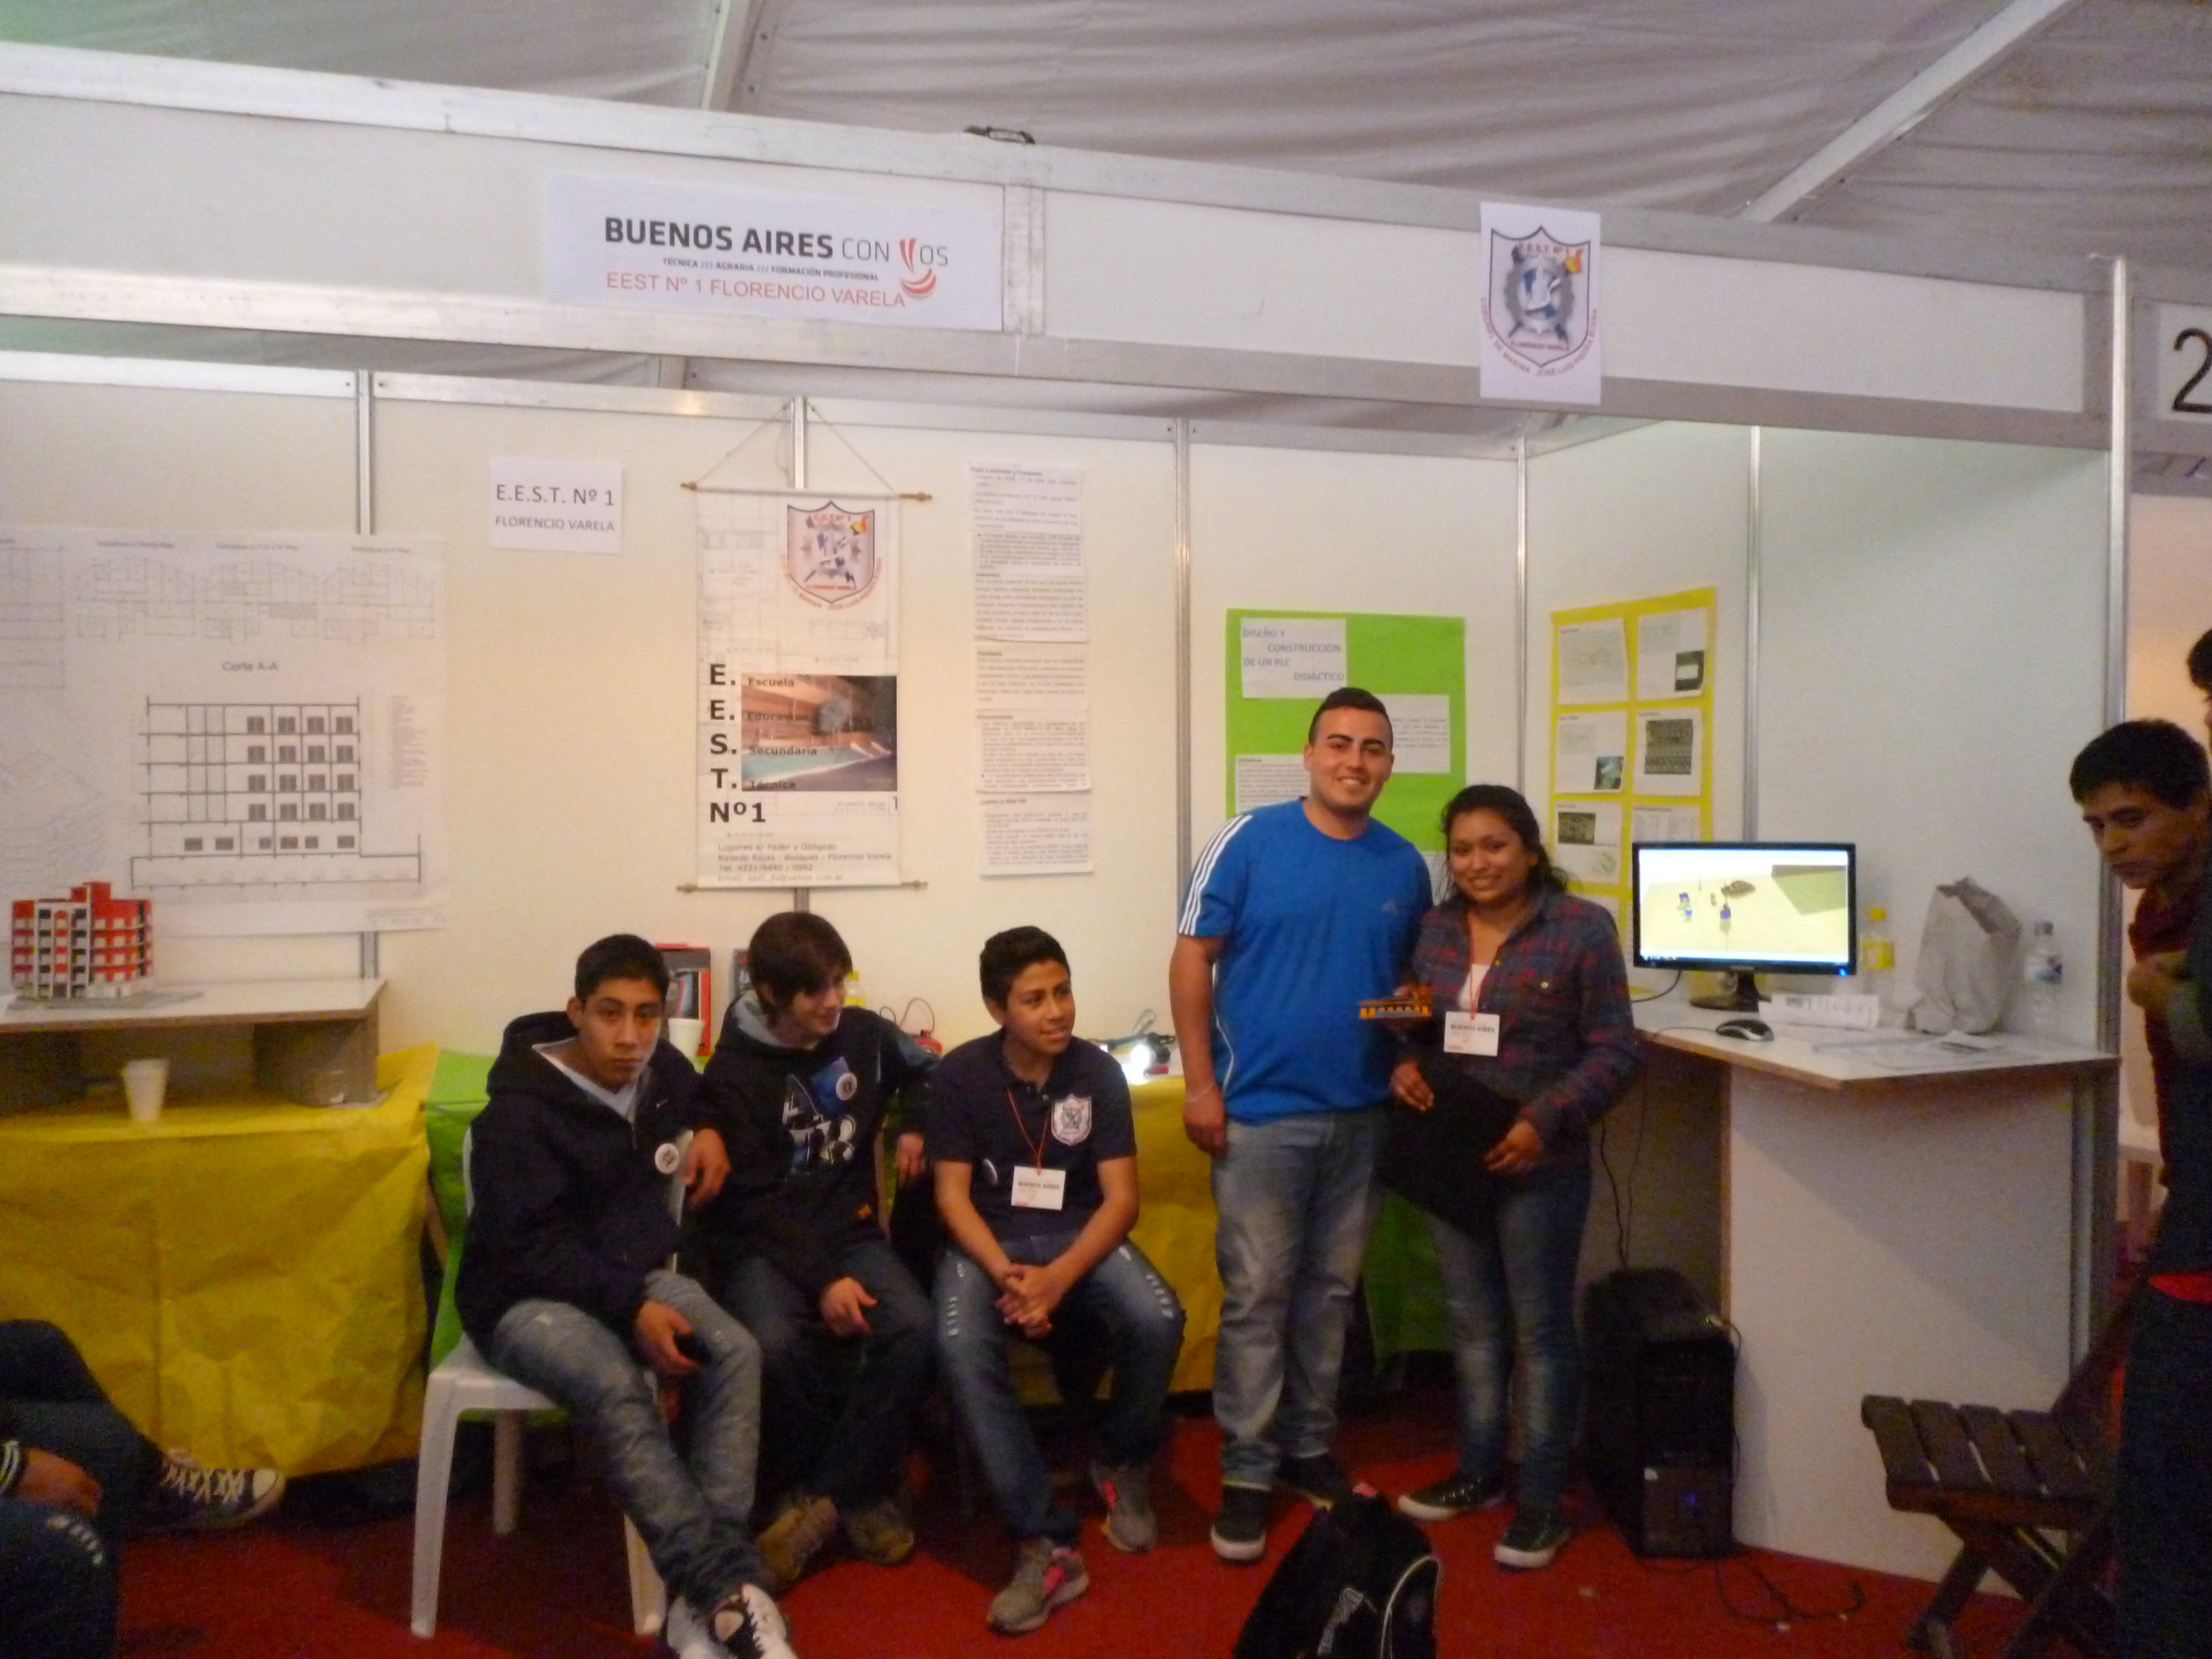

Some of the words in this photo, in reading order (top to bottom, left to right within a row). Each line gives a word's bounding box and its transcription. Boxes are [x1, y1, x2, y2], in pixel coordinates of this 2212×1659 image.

[606, 217, 733, 251] BUENOS
[742, 228, 833, 259] AIRES
[842, 238, 889, 262] CON
[716, 262, 754, 271] AGRARIA
[823, 269, 878, 280] PROFESIONAL
[607, 272, 659, 290] EEST
[695, 279, 702, 294] 1
[711, 279, 826, 302] FLORENCIO
[831, 288, 905, 307] VARELA
[2171, 328, 2212, 414] 2
[496, 484, 566, 504] E.E.S.T.
[605, 490, 614, 506] 1
[495, 515, 564, 529] FLORENCIO
[568, 520, 614, 531] VARELA
[1243, 627, 1277, 638] DISEÑO
[223, 661, 253, 671] Corte
[257, 661, 278, 671] A-A
[1244, 658, 1255, 666] DE
[1258, 658, 1272, 666] UN
[1275, 658, 1291, 667] PLC
[710, 664, 735, 686] E.
[748, 677, 794, 687] Escuela
[710, 700, 735, 720] E.
[710, 734, 737, 754] S.
[749, 746, 817, 755] Secundaria
[711, 768, 737, 789] T.
[718, 844, 753, 852] Lugones
